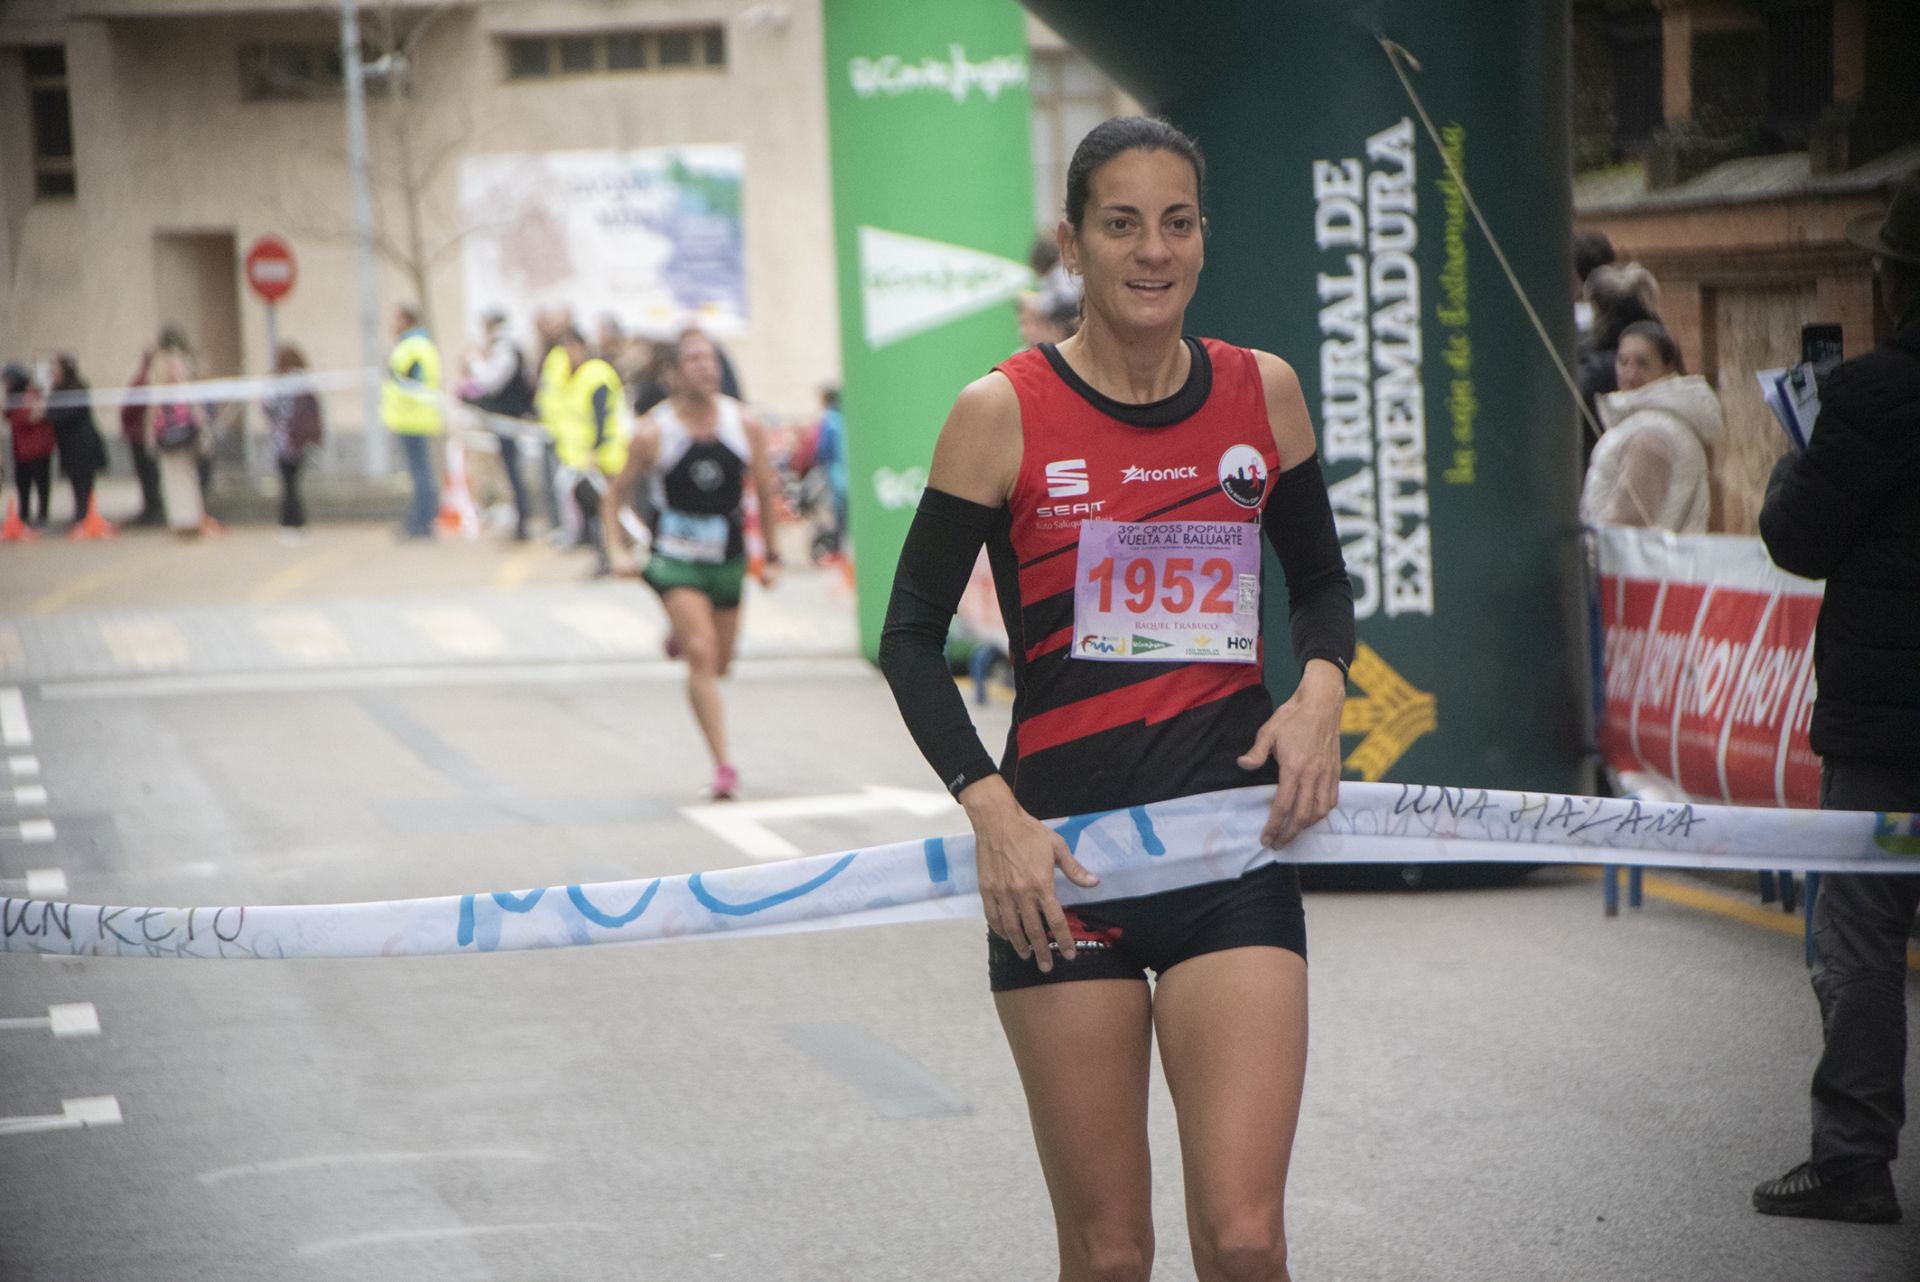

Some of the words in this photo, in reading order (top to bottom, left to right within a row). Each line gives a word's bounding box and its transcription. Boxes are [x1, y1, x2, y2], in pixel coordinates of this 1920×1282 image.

[1313, 158, 1364, 250] DE
[1317, 254, 1374, 464] RURAL
[1366, 116, 1434, 617] EXTREMADURA
[1036, 500, 1106, 517] SEAT
[1144, 525, 1182, 534] CROSS
[1187, 525, 1243, 534] POPULAR
[1118, 534, 1160, 545] VUELTA
[1164, 534, 1178, 544] AL
[1183, 533, 1243, 545] BALUARTE
[1328, 466, 1381, 620] CAJA
[1088, 557, 1234, 614] 1952
[1227, 636, 1254, 650] HOY
[1394, 783, 1499, 821] UNA
[3, 896, 72, 940] UN
